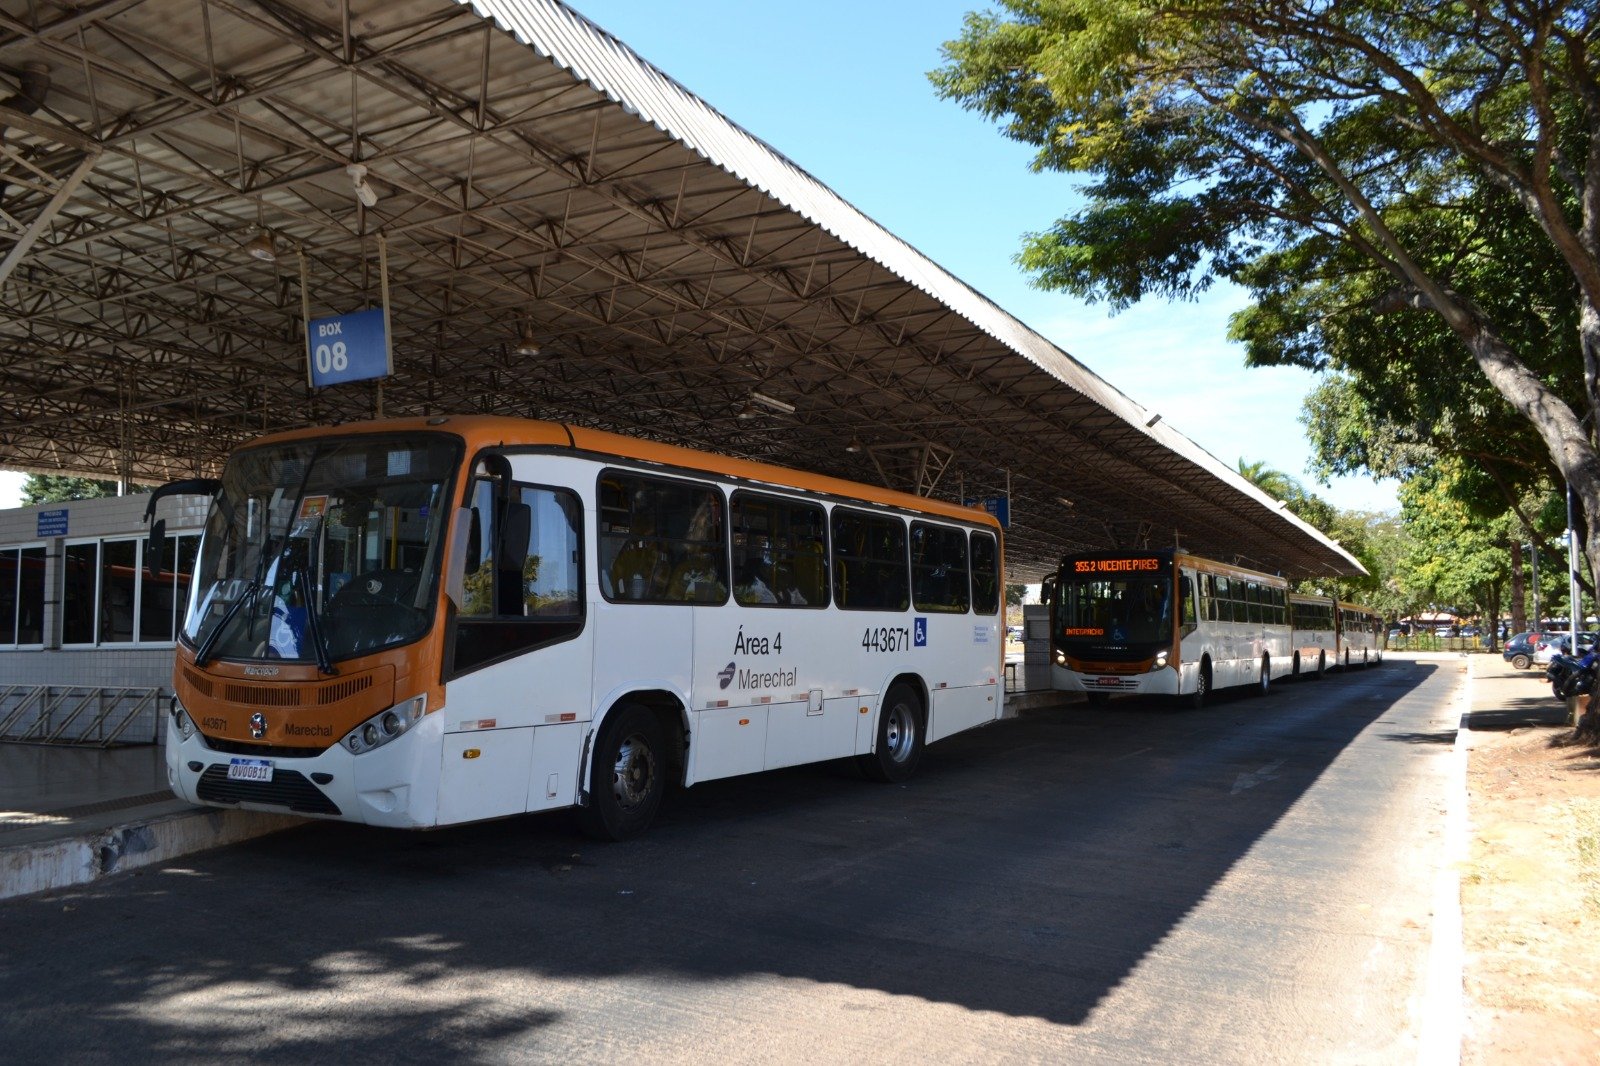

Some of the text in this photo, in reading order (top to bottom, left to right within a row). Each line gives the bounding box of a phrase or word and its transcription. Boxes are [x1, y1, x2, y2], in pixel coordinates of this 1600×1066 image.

[319, 322, 342, 337] BOX
[316, 341, 348, 374] 08
[1075, 559, 1158, 572] 355.2 VICENTE PIRES
[733, 624, 782, 655] Área 4
[862, 627, 909, 653] 443671
[738, 666, 797, 690] Marechal
[202, 717, 227, 731] 443671
[285, 723, 333, 736] Marechal
